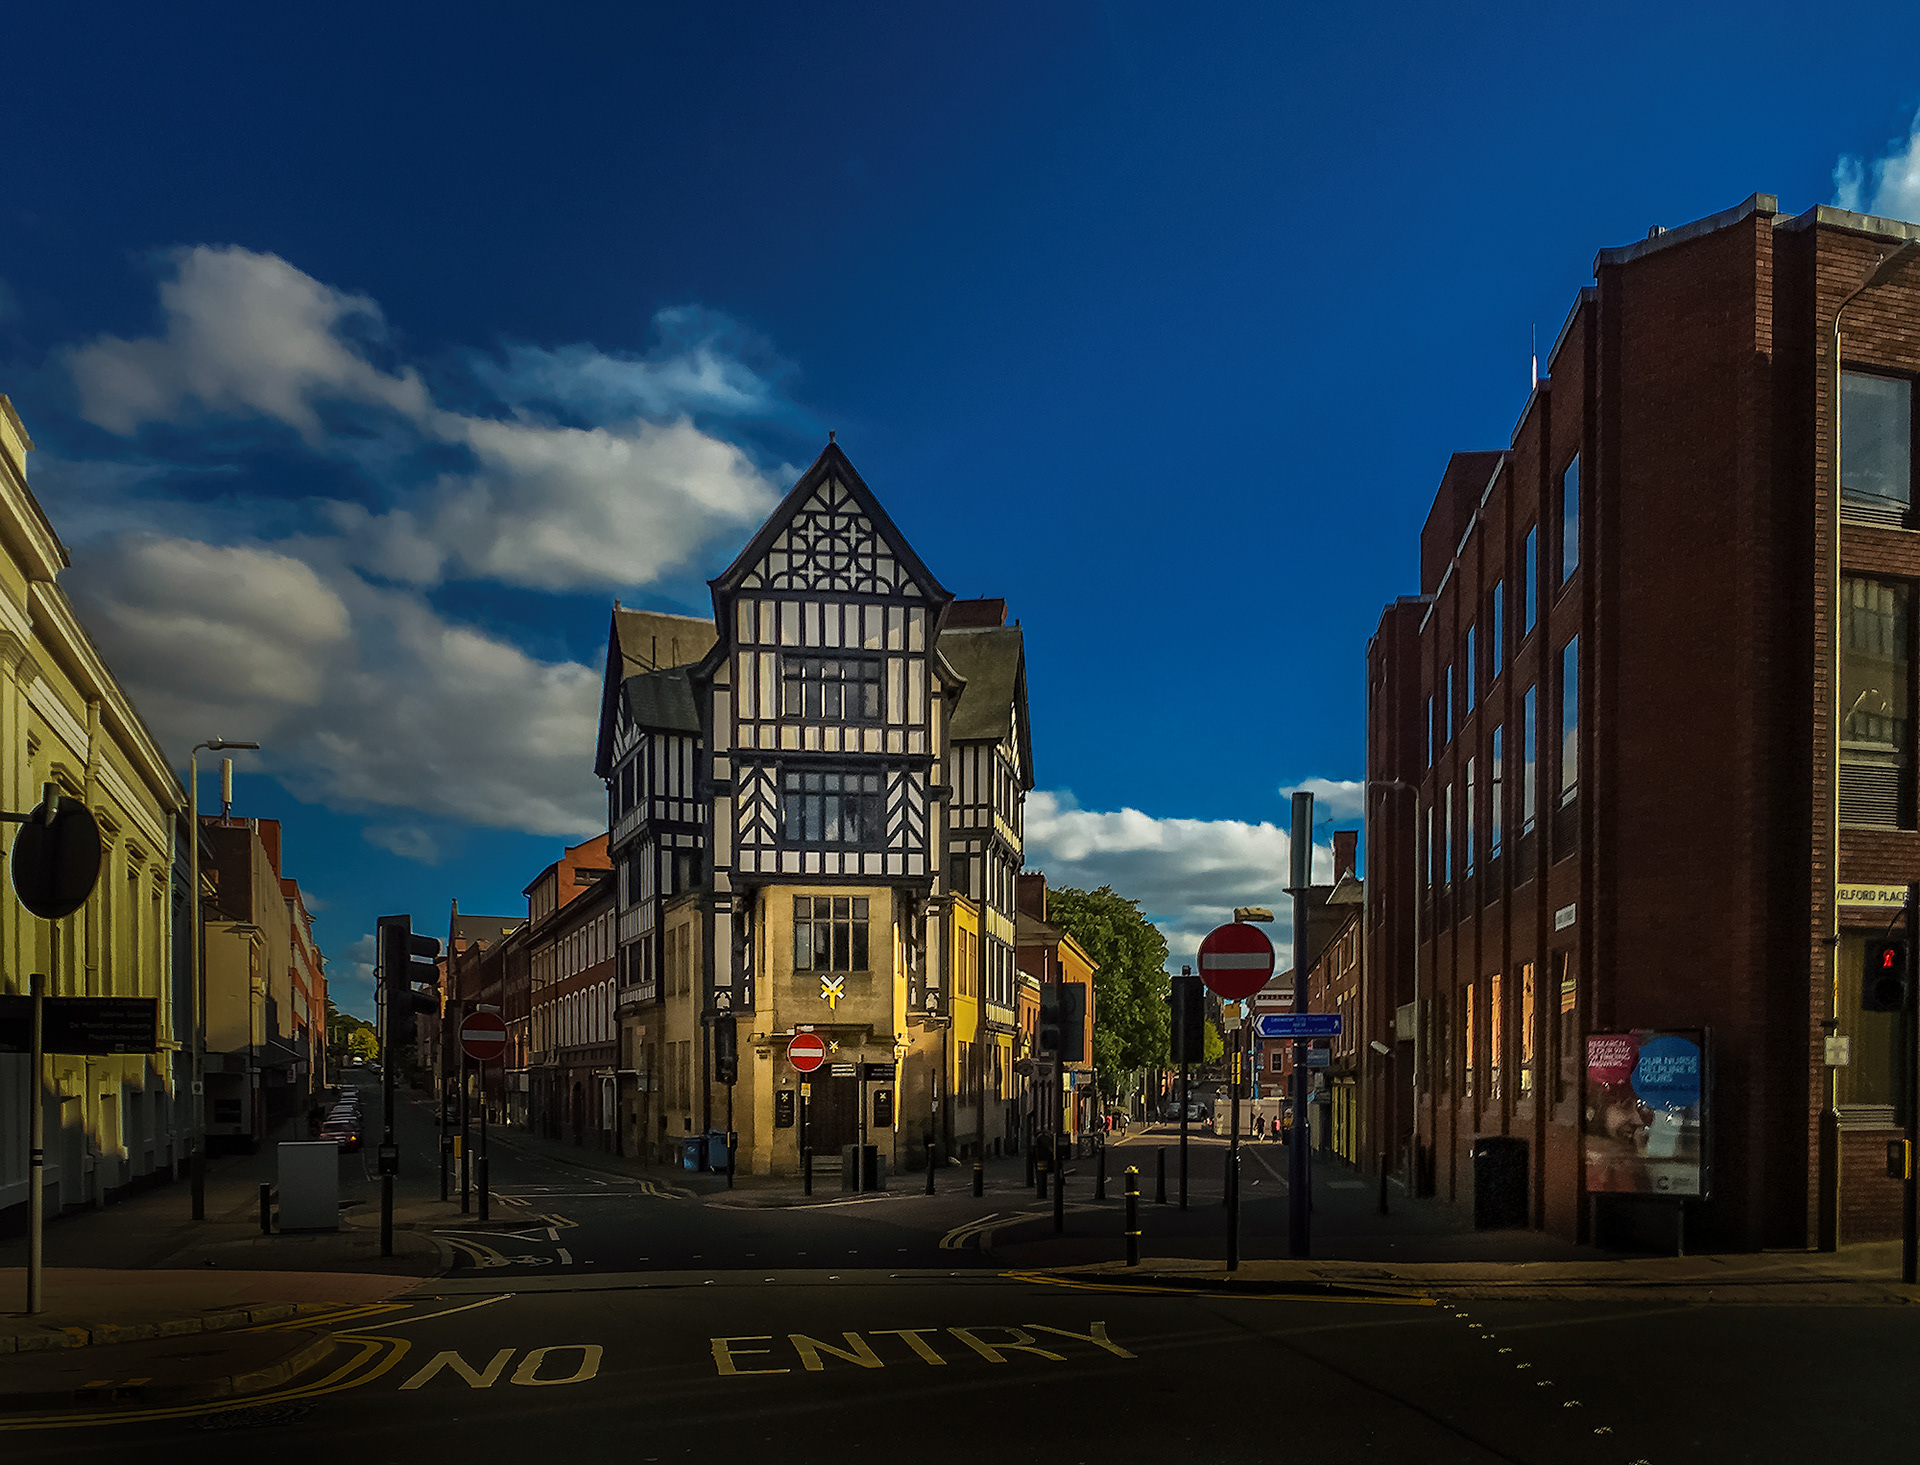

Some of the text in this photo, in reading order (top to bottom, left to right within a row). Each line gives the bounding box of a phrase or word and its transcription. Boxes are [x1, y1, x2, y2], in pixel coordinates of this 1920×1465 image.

[1638, 1056, 1697, 1065] OUR NURSE
[397, 1321, 1139, 1391] NO ENTRY
